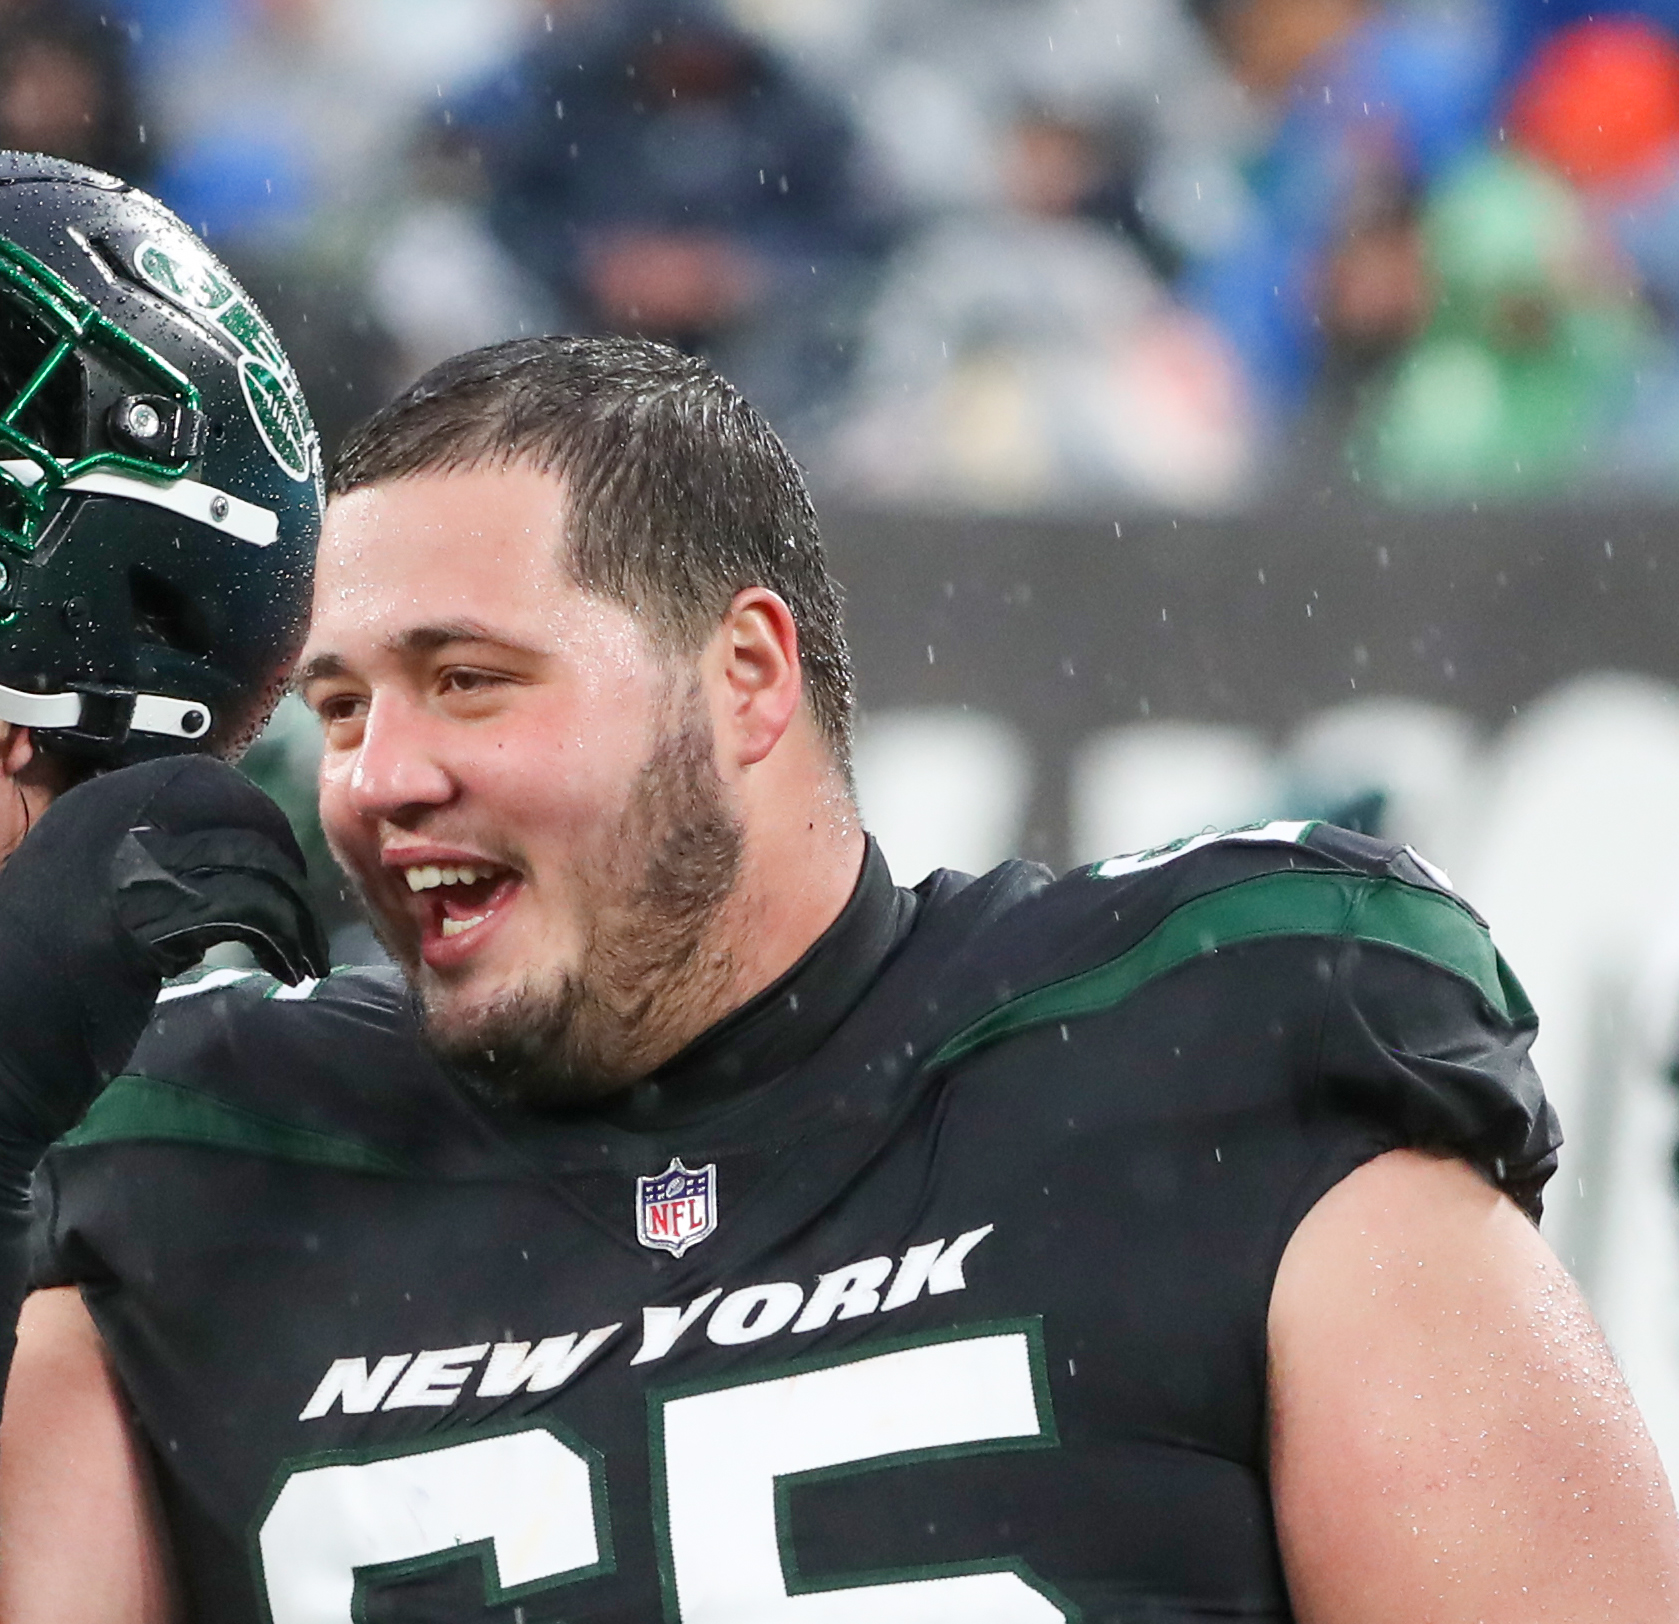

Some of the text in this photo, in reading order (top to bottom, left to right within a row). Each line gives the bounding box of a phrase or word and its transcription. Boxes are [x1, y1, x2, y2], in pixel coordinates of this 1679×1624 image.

[649, 1199, 703, 1237] NFL
[298, 1223, 994, 1422] NEW YORK
